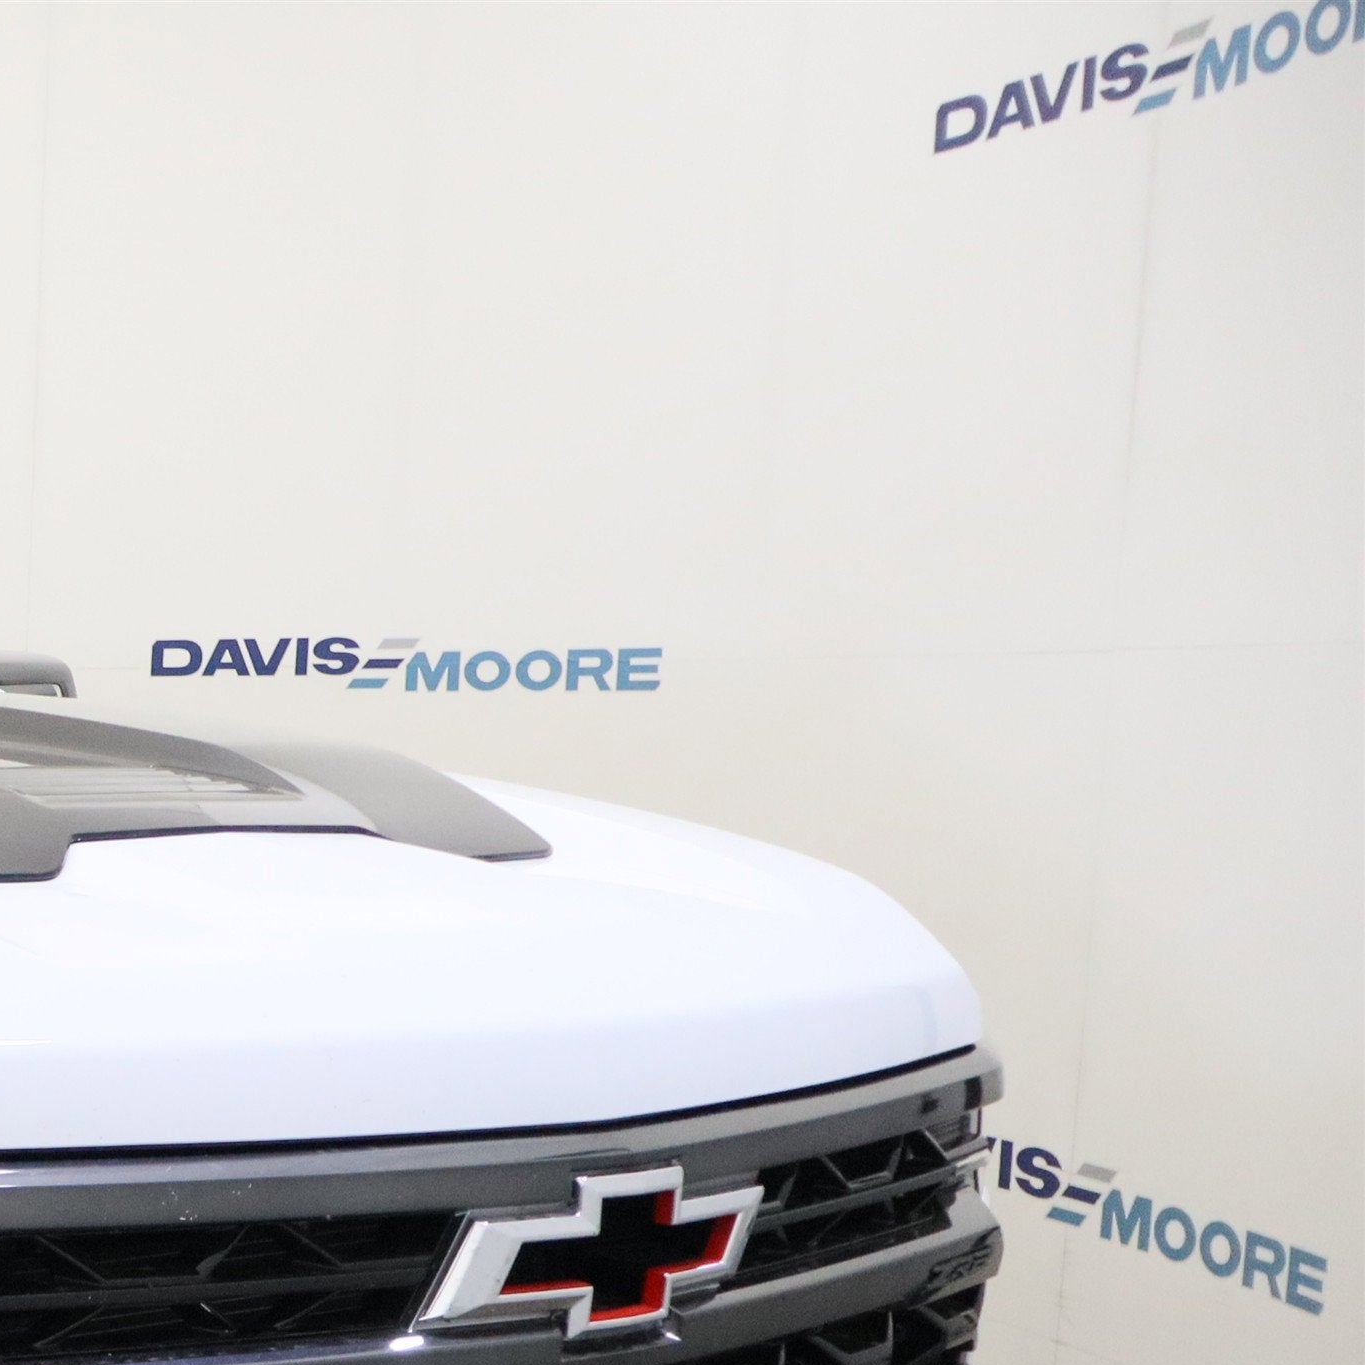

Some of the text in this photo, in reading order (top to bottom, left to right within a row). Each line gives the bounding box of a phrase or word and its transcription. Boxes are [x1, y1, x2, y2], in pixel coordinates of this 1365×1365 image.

[1192, 0, 1365, 99] MOO
[150, 637, 663, 692] DAVIS MOORE
[1099, 1188, 1329, 1316] MOORE
